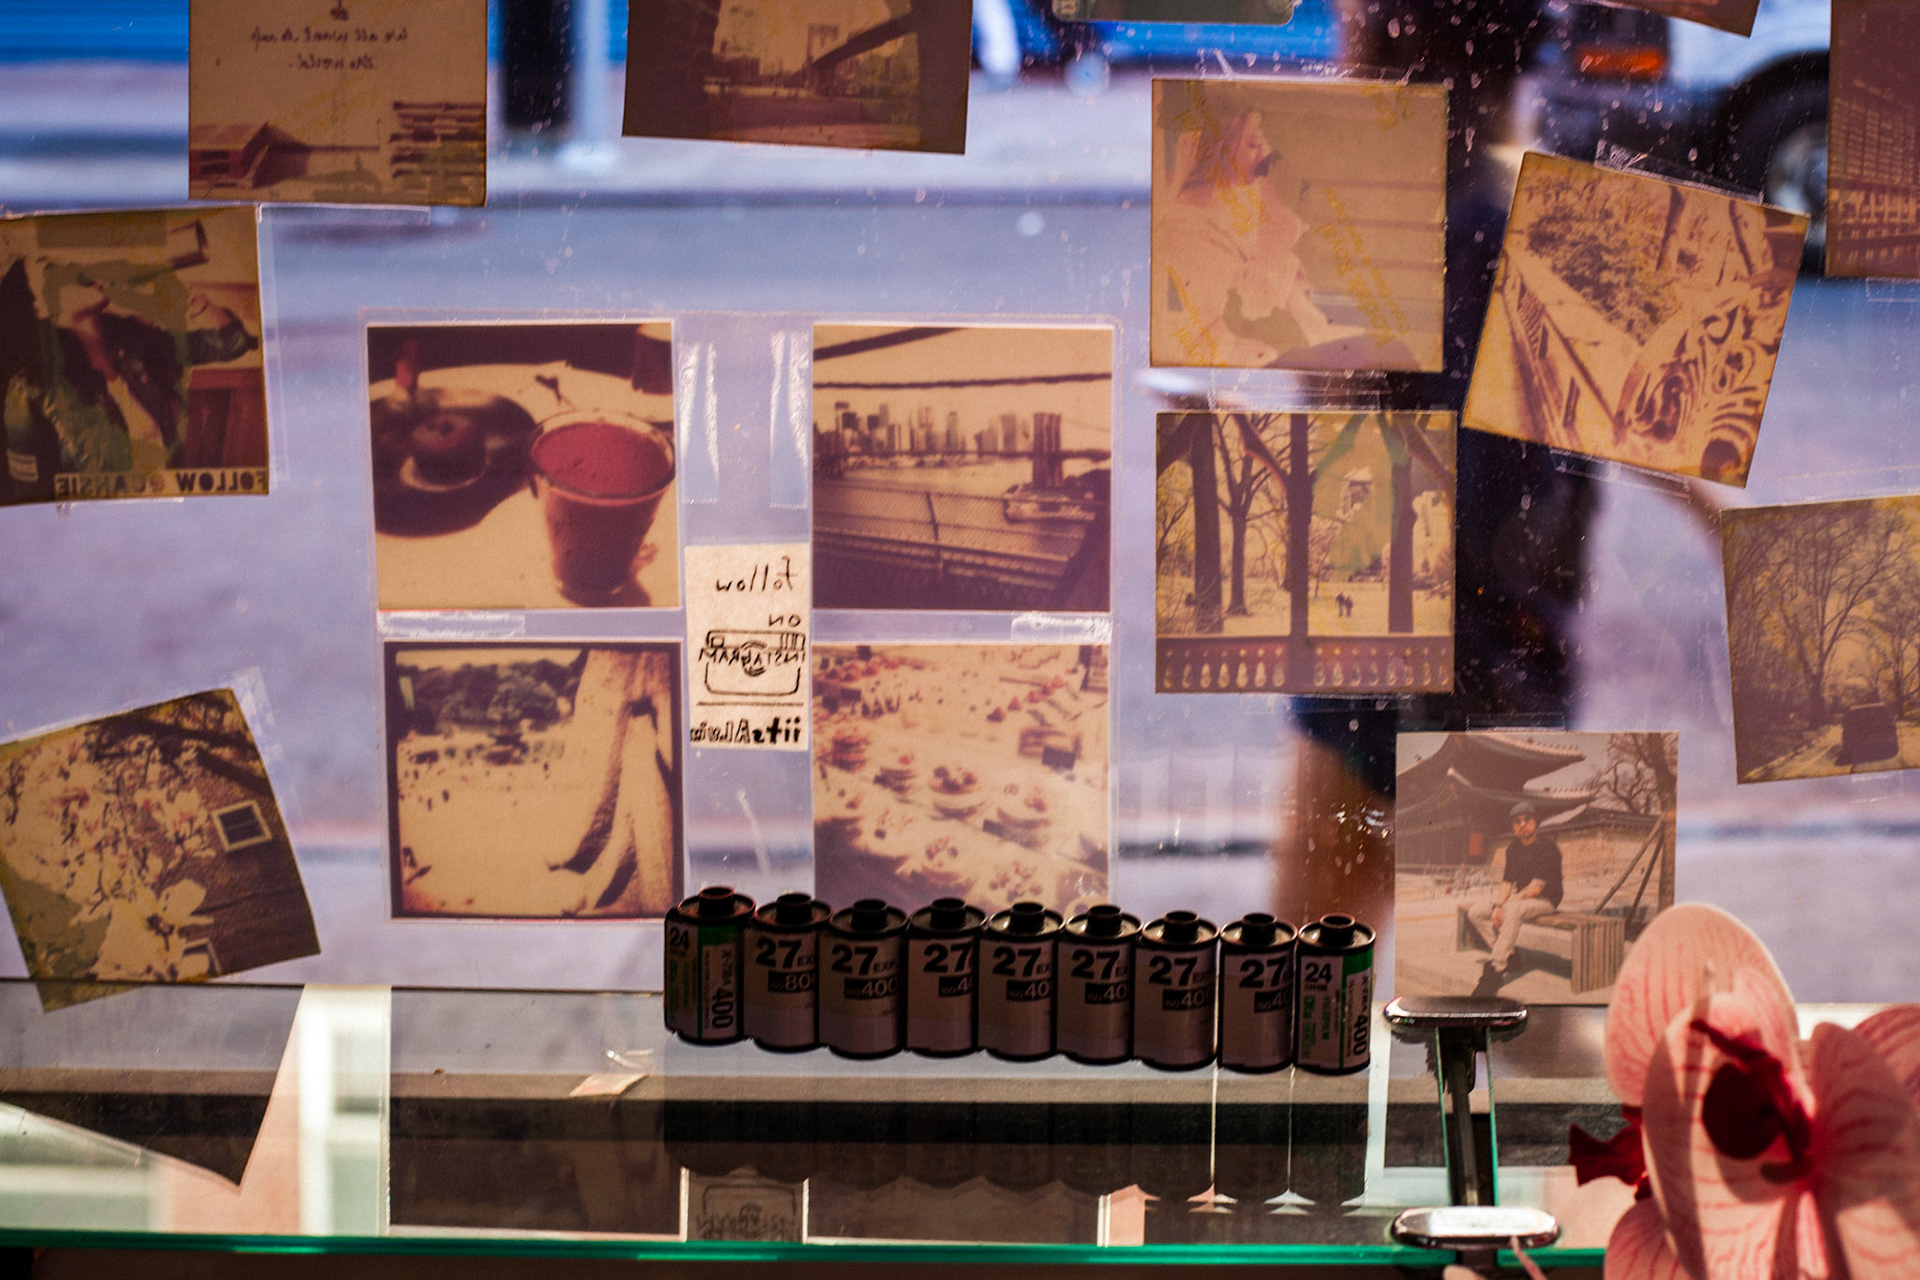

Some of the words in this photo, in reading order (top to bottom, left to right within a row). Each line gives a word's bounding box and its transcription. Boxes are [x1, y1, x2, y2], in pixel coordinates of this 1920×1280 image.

[1313, 221, 1357, 277] Royal
[1345, 272, 1397, 350] Kodak
[669, 927, 690, 950] 24
[756, 937, 802, 969] 27
[832, 943, 878, 976] 27
[923, 942, 972, 973] 27
[992, 946, 1042, 977] 27
[1071, 949, 1120, 980] 27
[1149, 955, 1198, 987] 27
[1239, 957, 1287, 988] 27
[1304, 963, 1333, 983] 24
[784, 973, 816, 991] 80
[861, 977, 900, 998] 400
[711, 987, 734, 1028] 400
[1353, 1014, 1369, 1056] 400
